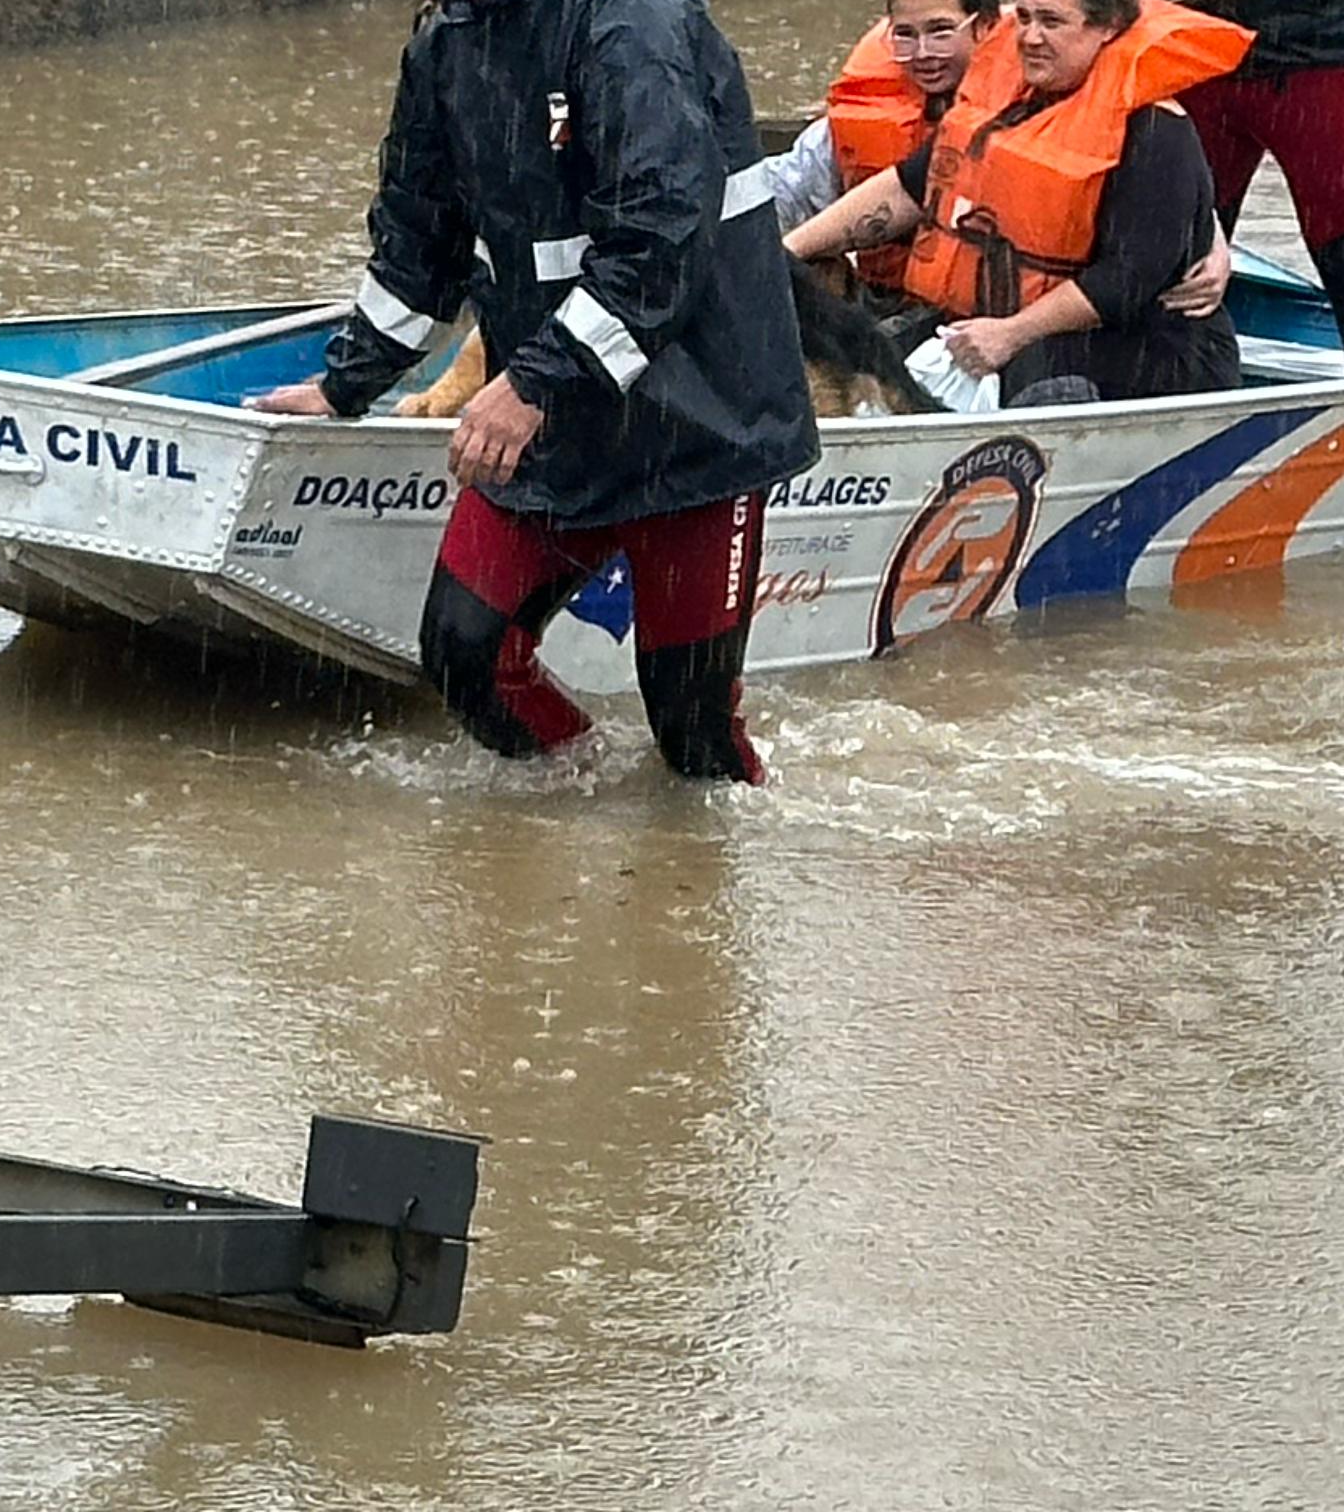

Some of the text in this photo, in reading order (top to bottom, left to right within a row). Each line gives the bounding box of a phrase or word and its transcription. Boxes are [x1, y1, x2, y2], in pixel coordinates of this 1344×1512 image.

[46, 423, 197, 483] CIVIL
[293, 471, 891, 519] DOAÇÃO A-LAGES
